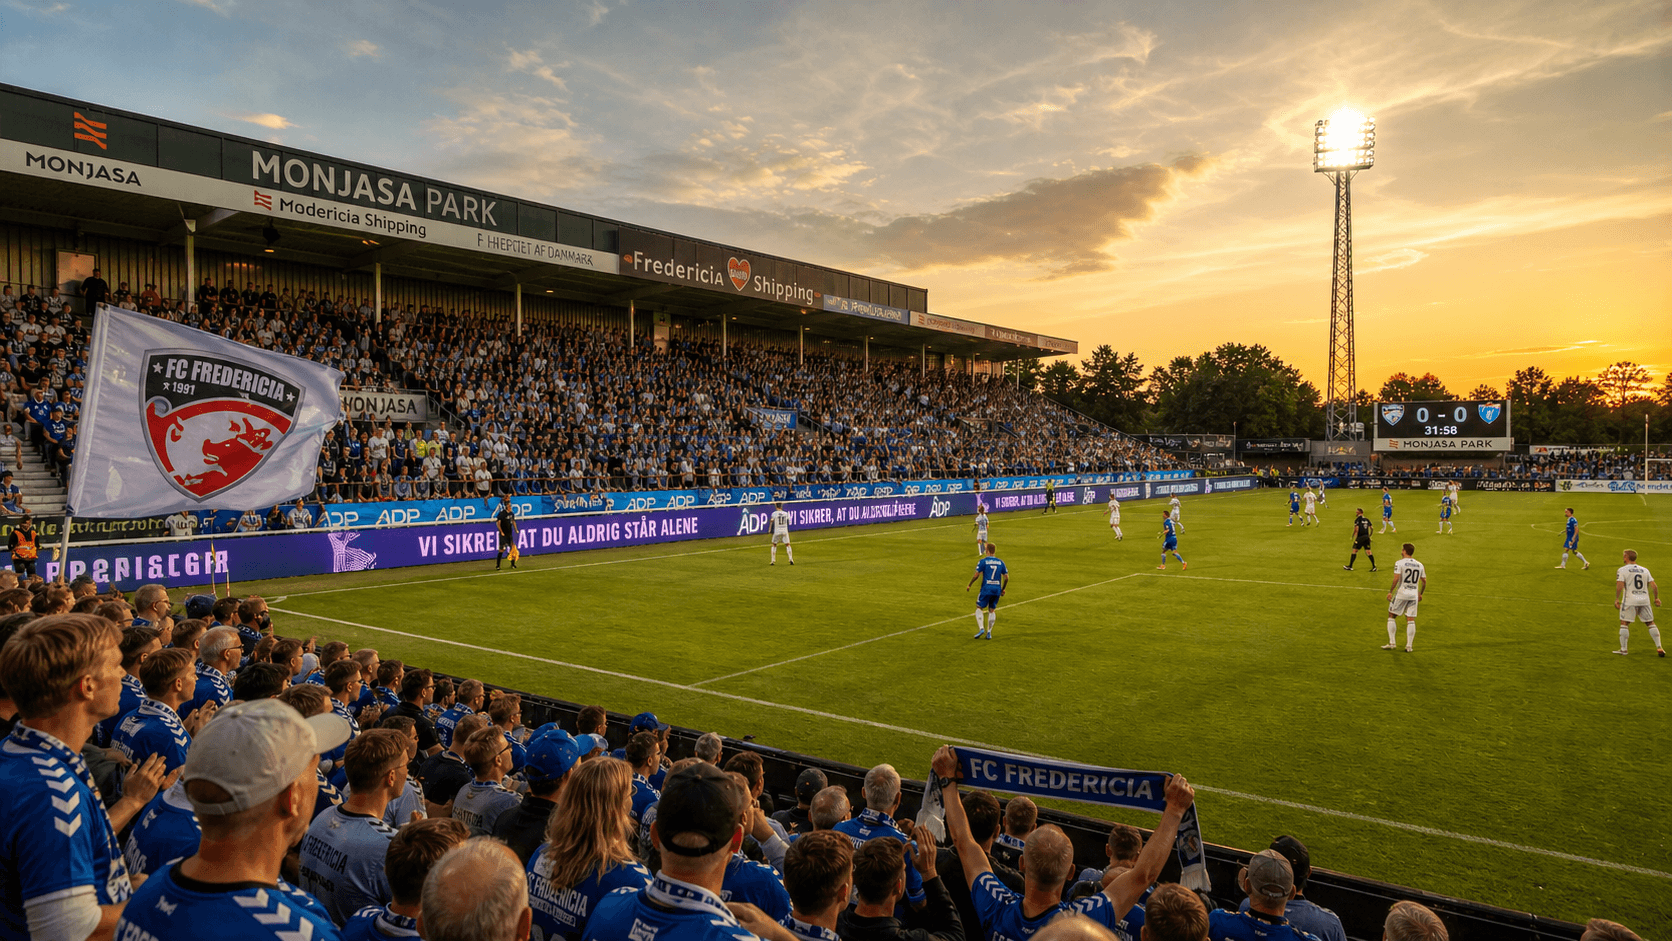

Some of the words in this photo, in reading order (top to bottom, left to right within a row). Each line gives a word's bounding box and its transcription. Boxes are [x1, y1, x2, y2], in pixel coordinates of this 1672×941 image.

[25, 151, 142, 187] MONJASA
[252, 150, 417, 211] MONJASA
[427, 187, 497, 227] PARK
[279, 197, 360, 225] Modericia
[365, 213, 427, 239] Shipping
[753, 275, 814, 305] Shipping
[165, 357, 188, 379] FC
[191, 359, 285, 402] FREDERICIA
[172, 381, 196, 396] 1991
[1416, 407, 1429, 423] 0
[1453, 406, 1468, 423] 0
[1403, 440, 1456, 449] MONJASA
[1460, 440, 1492, 448] PARK
[625, 497, 656, 511] ADP
[667, 495, 695, 510] ADP
[739, 492, 766, 504] ADP
[376, 509, 420, 527] ADP
[435, 505, 476, 522] ADP
[836, 507, 847, 521] AT
[418, 534, 437, 557] VI
[517, 528, 538, 549] AT
[542, 526, 563, 547] DU
[567, 522, 620, 545] ALDRIG
[624, 515, 657, 539] STÅR
[660, 516, 698, 536] ALENE
[989, 565, 998, 580] 7
[1404, 568, 1420, 584] 20
[1634, 574, 1644, 590] 6
[969, 757, 998, 781] FC
[1004, 762, 1154, 800] FREDERICIA
